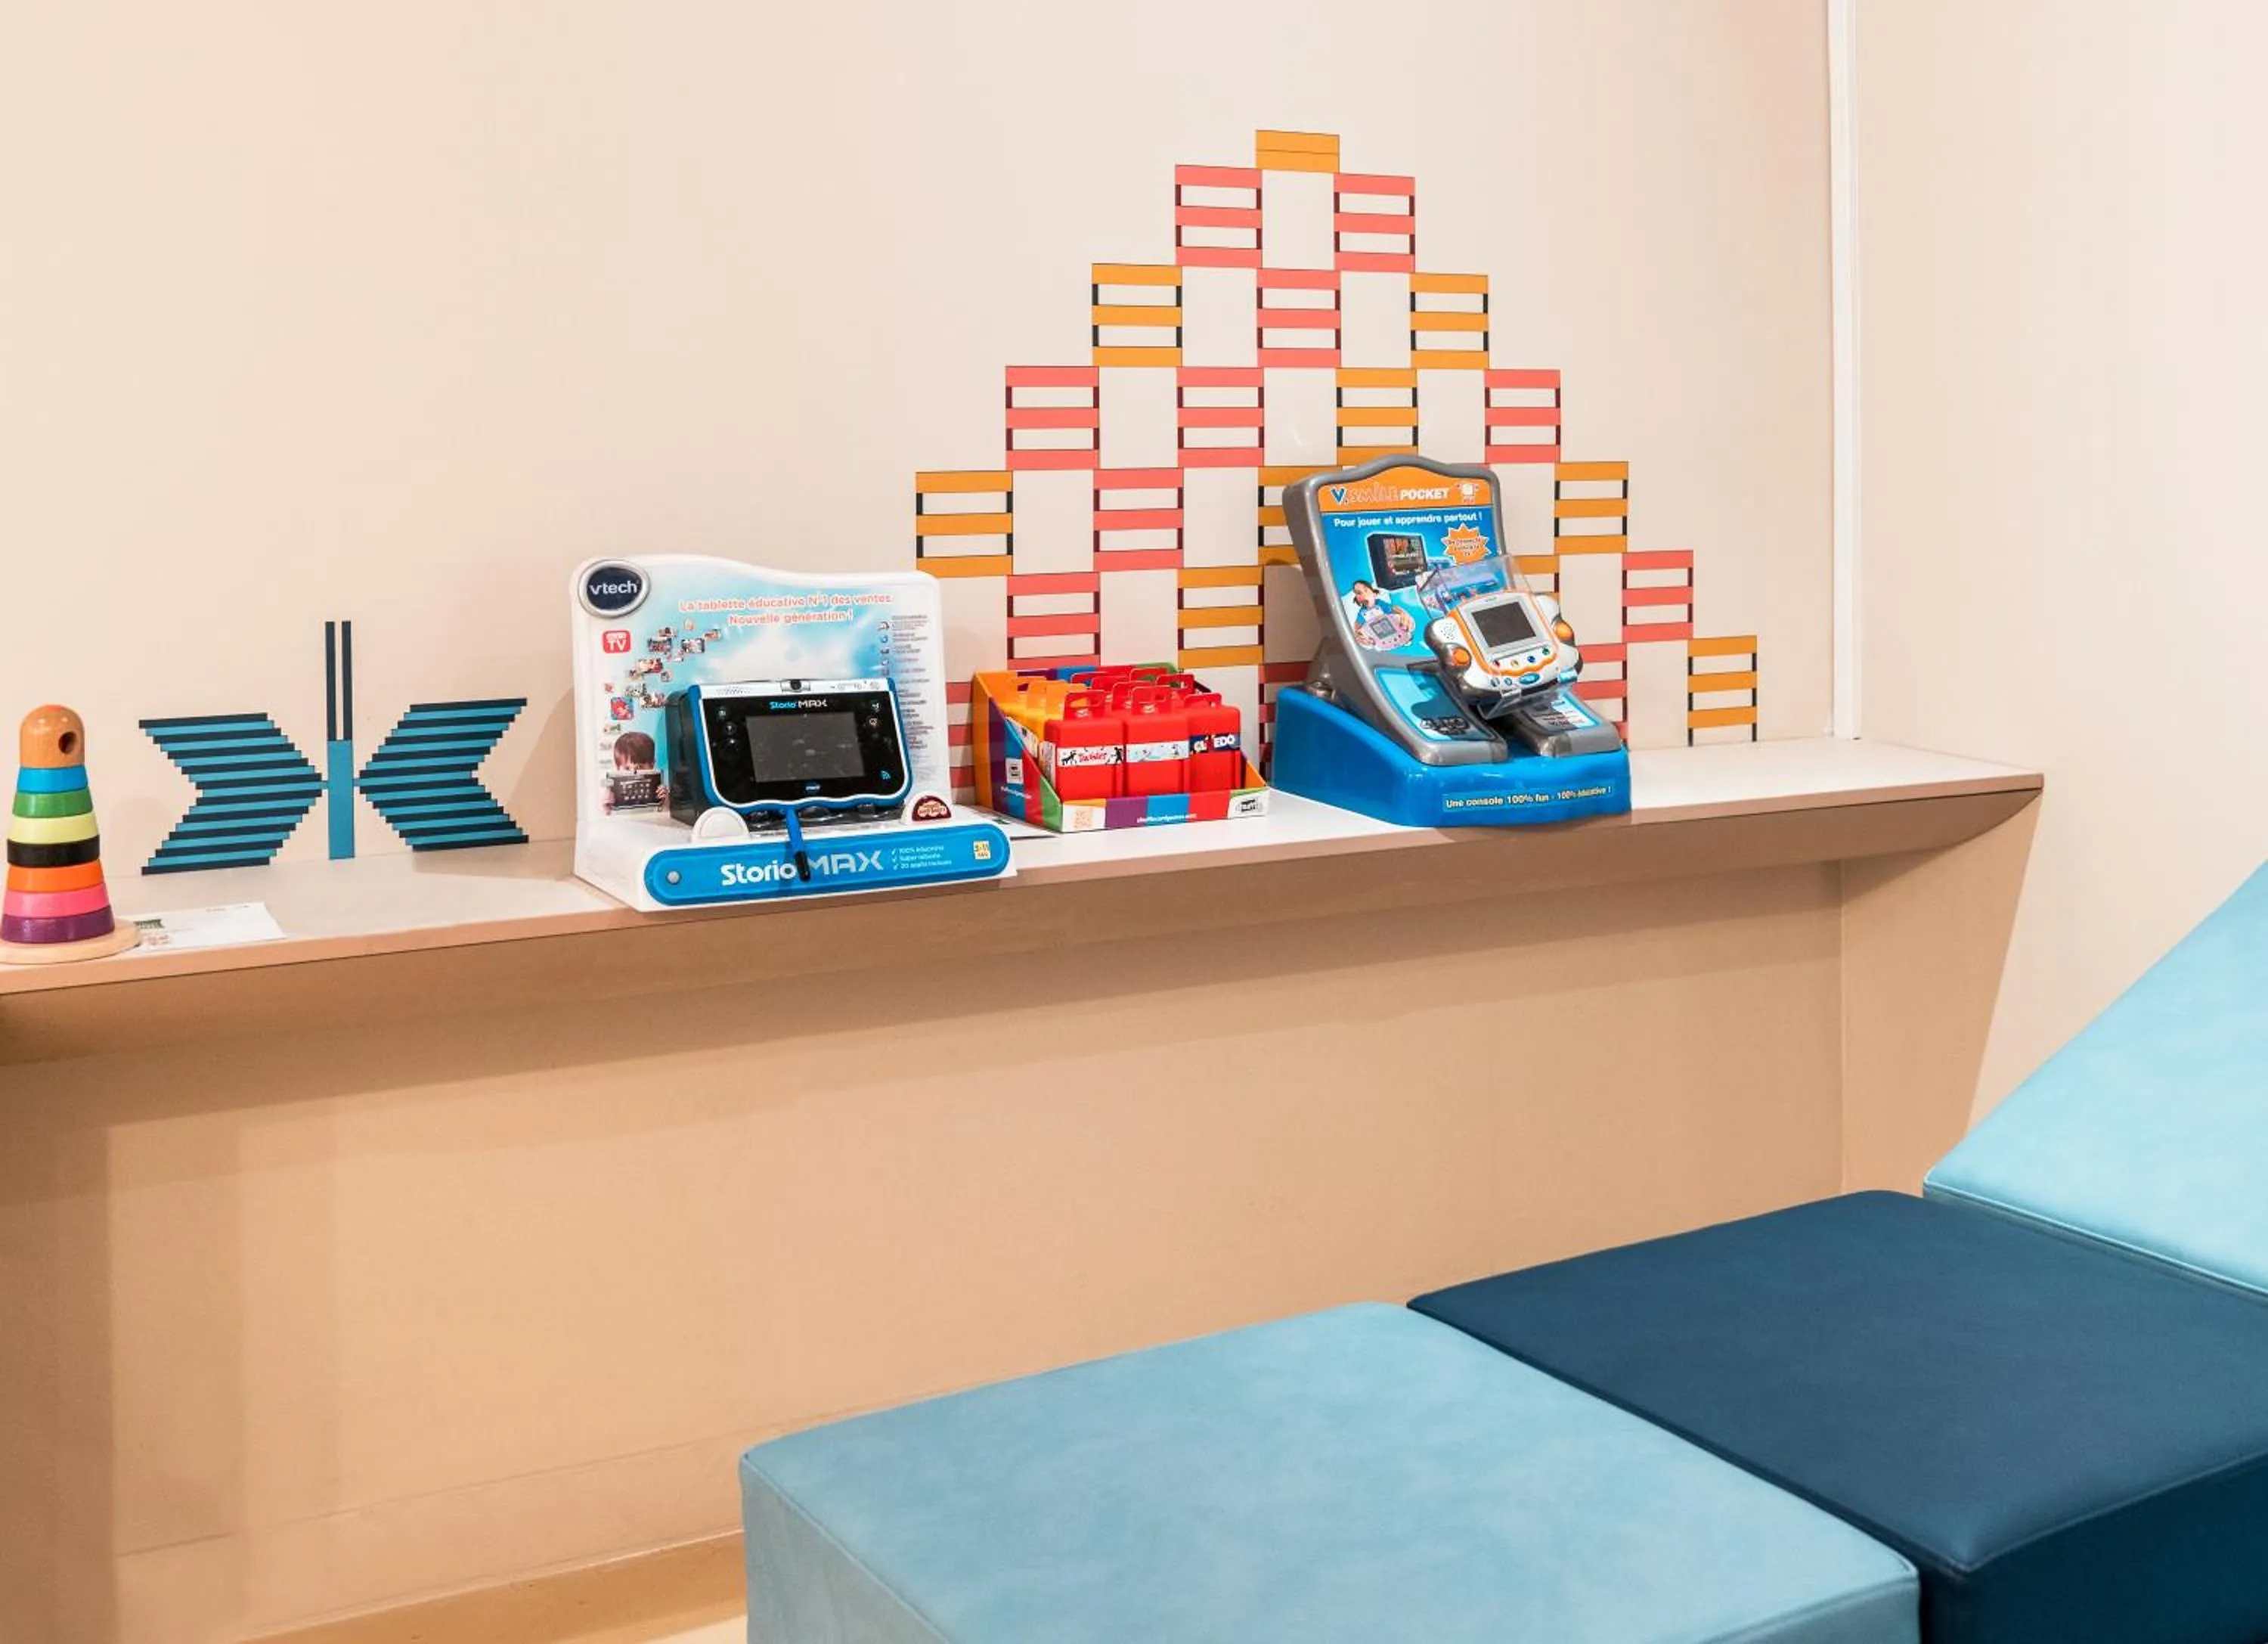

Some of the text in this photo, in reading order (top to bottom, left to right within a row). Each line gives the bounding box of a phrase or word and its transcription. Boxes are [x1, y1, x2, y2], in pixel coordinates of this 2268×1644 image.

[1399, 487, 1449, 501] POCKET
[1334, 518, 1356, 528] Pour
[1358, 516, 1382, 529] jouer
[1384, 516, 1393, 525] et
[1396, 513, 1442, 527] apprendre
[1445, 512, 1477, 523] partout
[589, 580, 638, 596] vtech
[680, 602, 696, 612] La
[699, 599, 745, 611] tablette
[748, 594, 807, 609] éducative
[832, 594, 851, 605] des
[729, 613, 780, 625] Nouvelle
[783, 610, 847, 624] génération
[606, 640, 627, 652] TV
[798, 699, 828, 709] MAX
[1446, 799, 1464, 808] Une
[1466, 796, 1504, 807] console
[1507, 795, 1533, 805] 100%
[1535, 793, 1549, 802] fun
[721, 860, 796, 886] Storio
